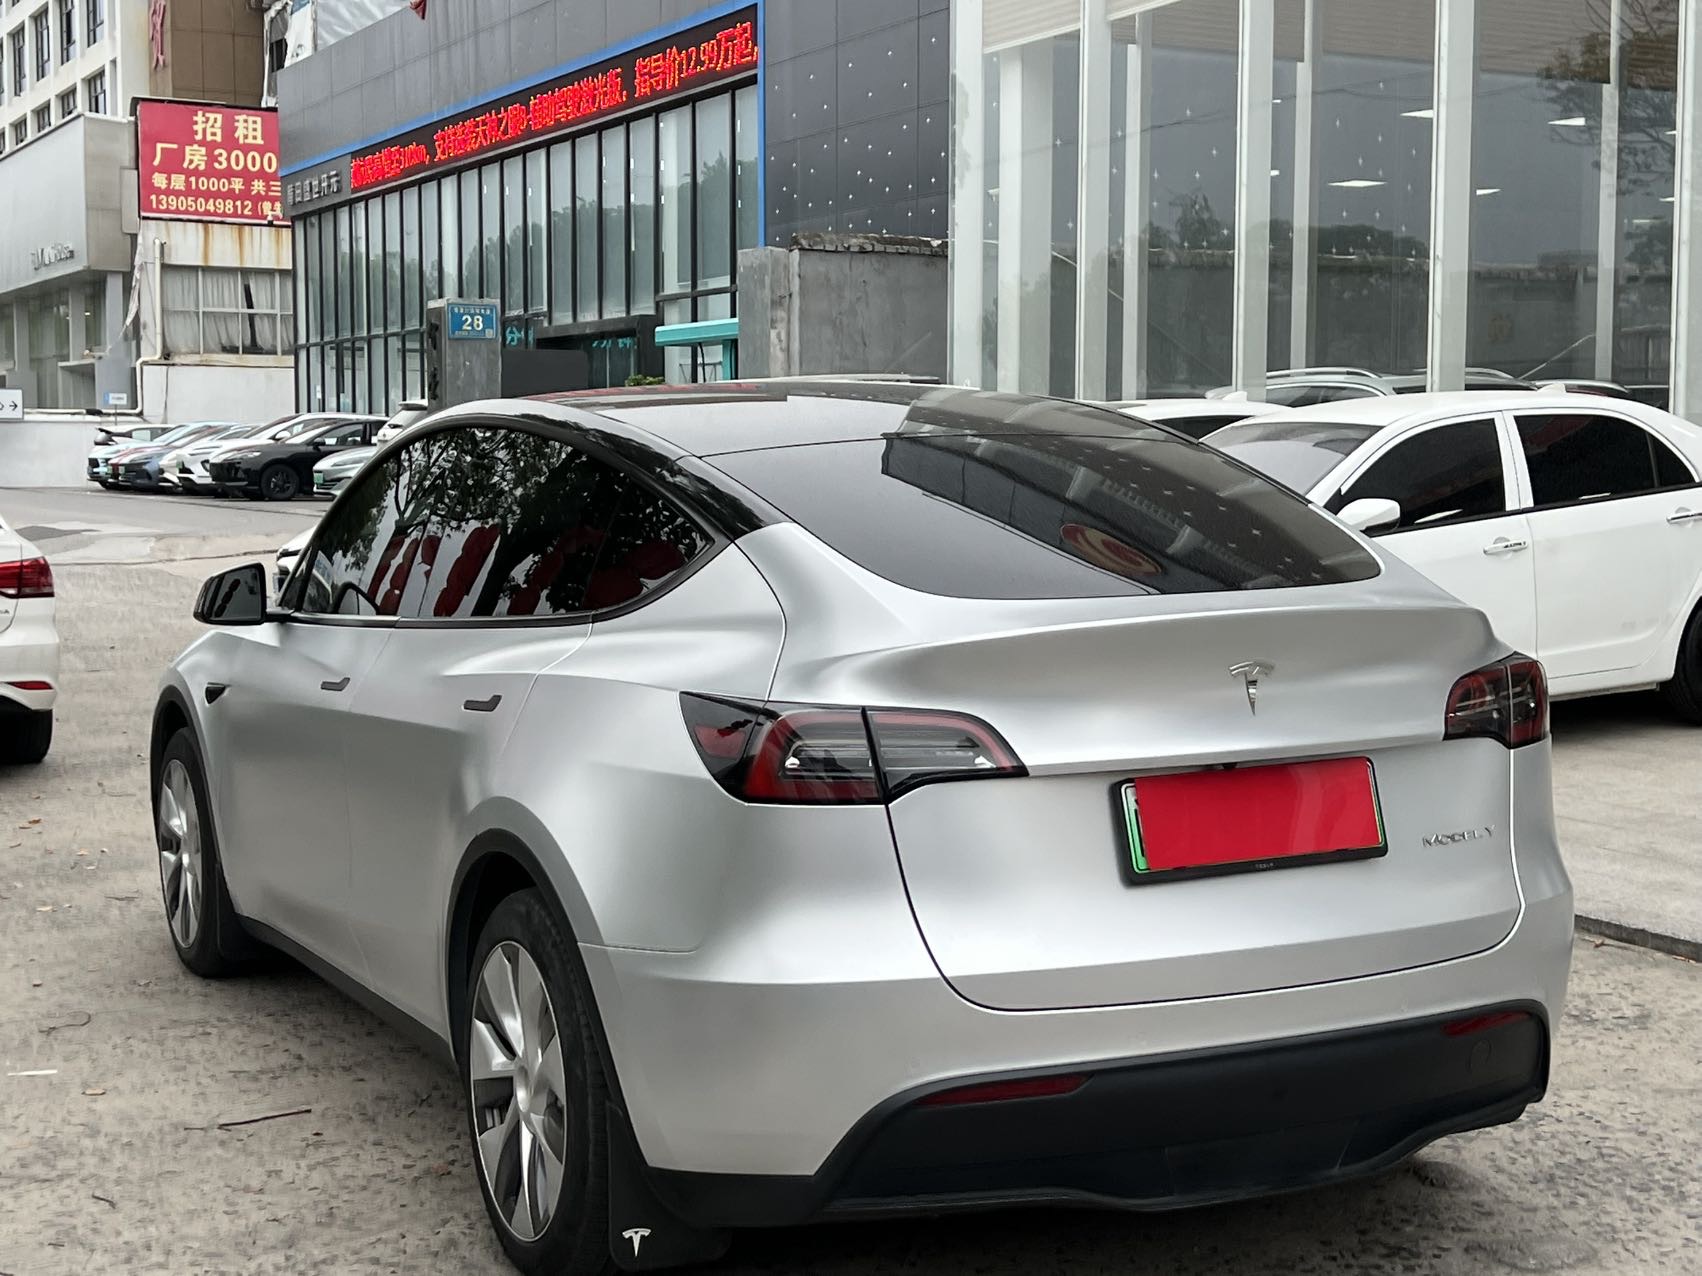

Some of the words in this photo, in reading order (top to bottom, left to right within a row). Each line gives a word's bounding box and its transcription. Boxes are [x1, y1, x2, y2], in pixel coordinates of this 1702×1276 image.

[151, 172, 244, 194] 每层1000平
[150, 194, 252, 215] 13905049812
[462, 314, 484, 331] 28
